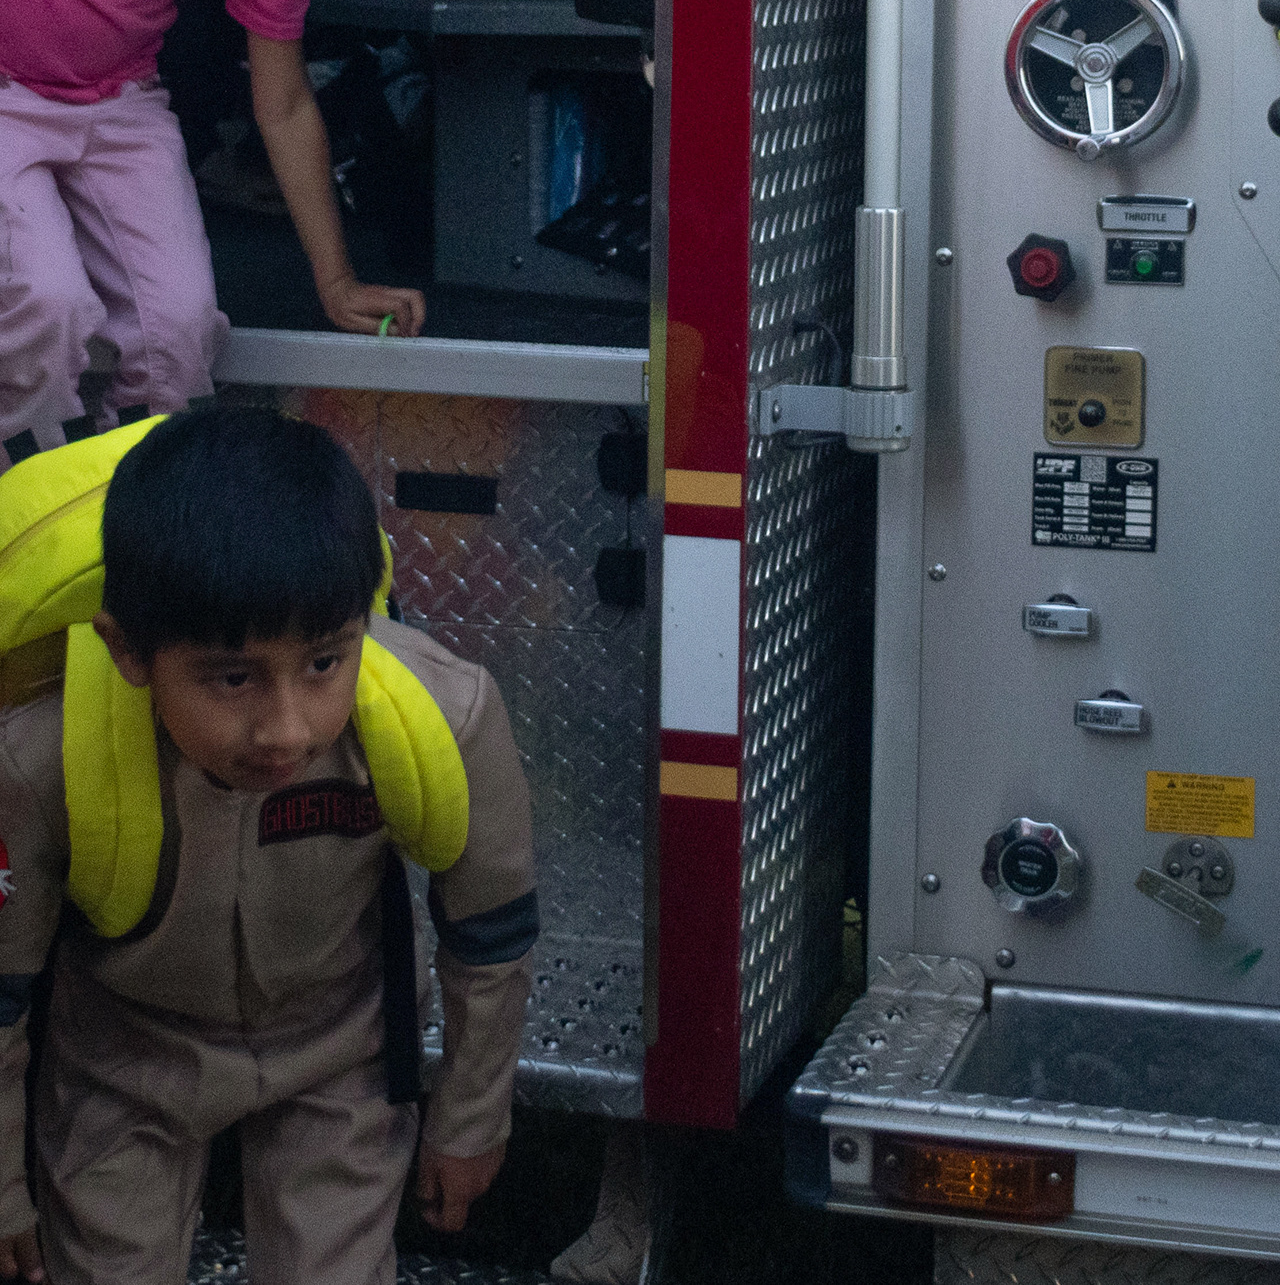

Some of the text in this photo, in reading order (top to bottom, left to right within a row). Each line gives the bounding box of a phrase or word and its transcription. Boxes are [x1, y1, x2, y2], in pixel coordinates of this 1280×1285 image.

[1124, 212, 1167, 222] THROTTLE
[1064, 364, 1121, 375] FIRE PUMP
[1028, 618, 1058, 628] COOLER
[1079, 714, 1119, 726] BLOWOUT
[1182, 781, 1225, 791] WARNING
[263, 791, 378, 837] GHOSTBUS
